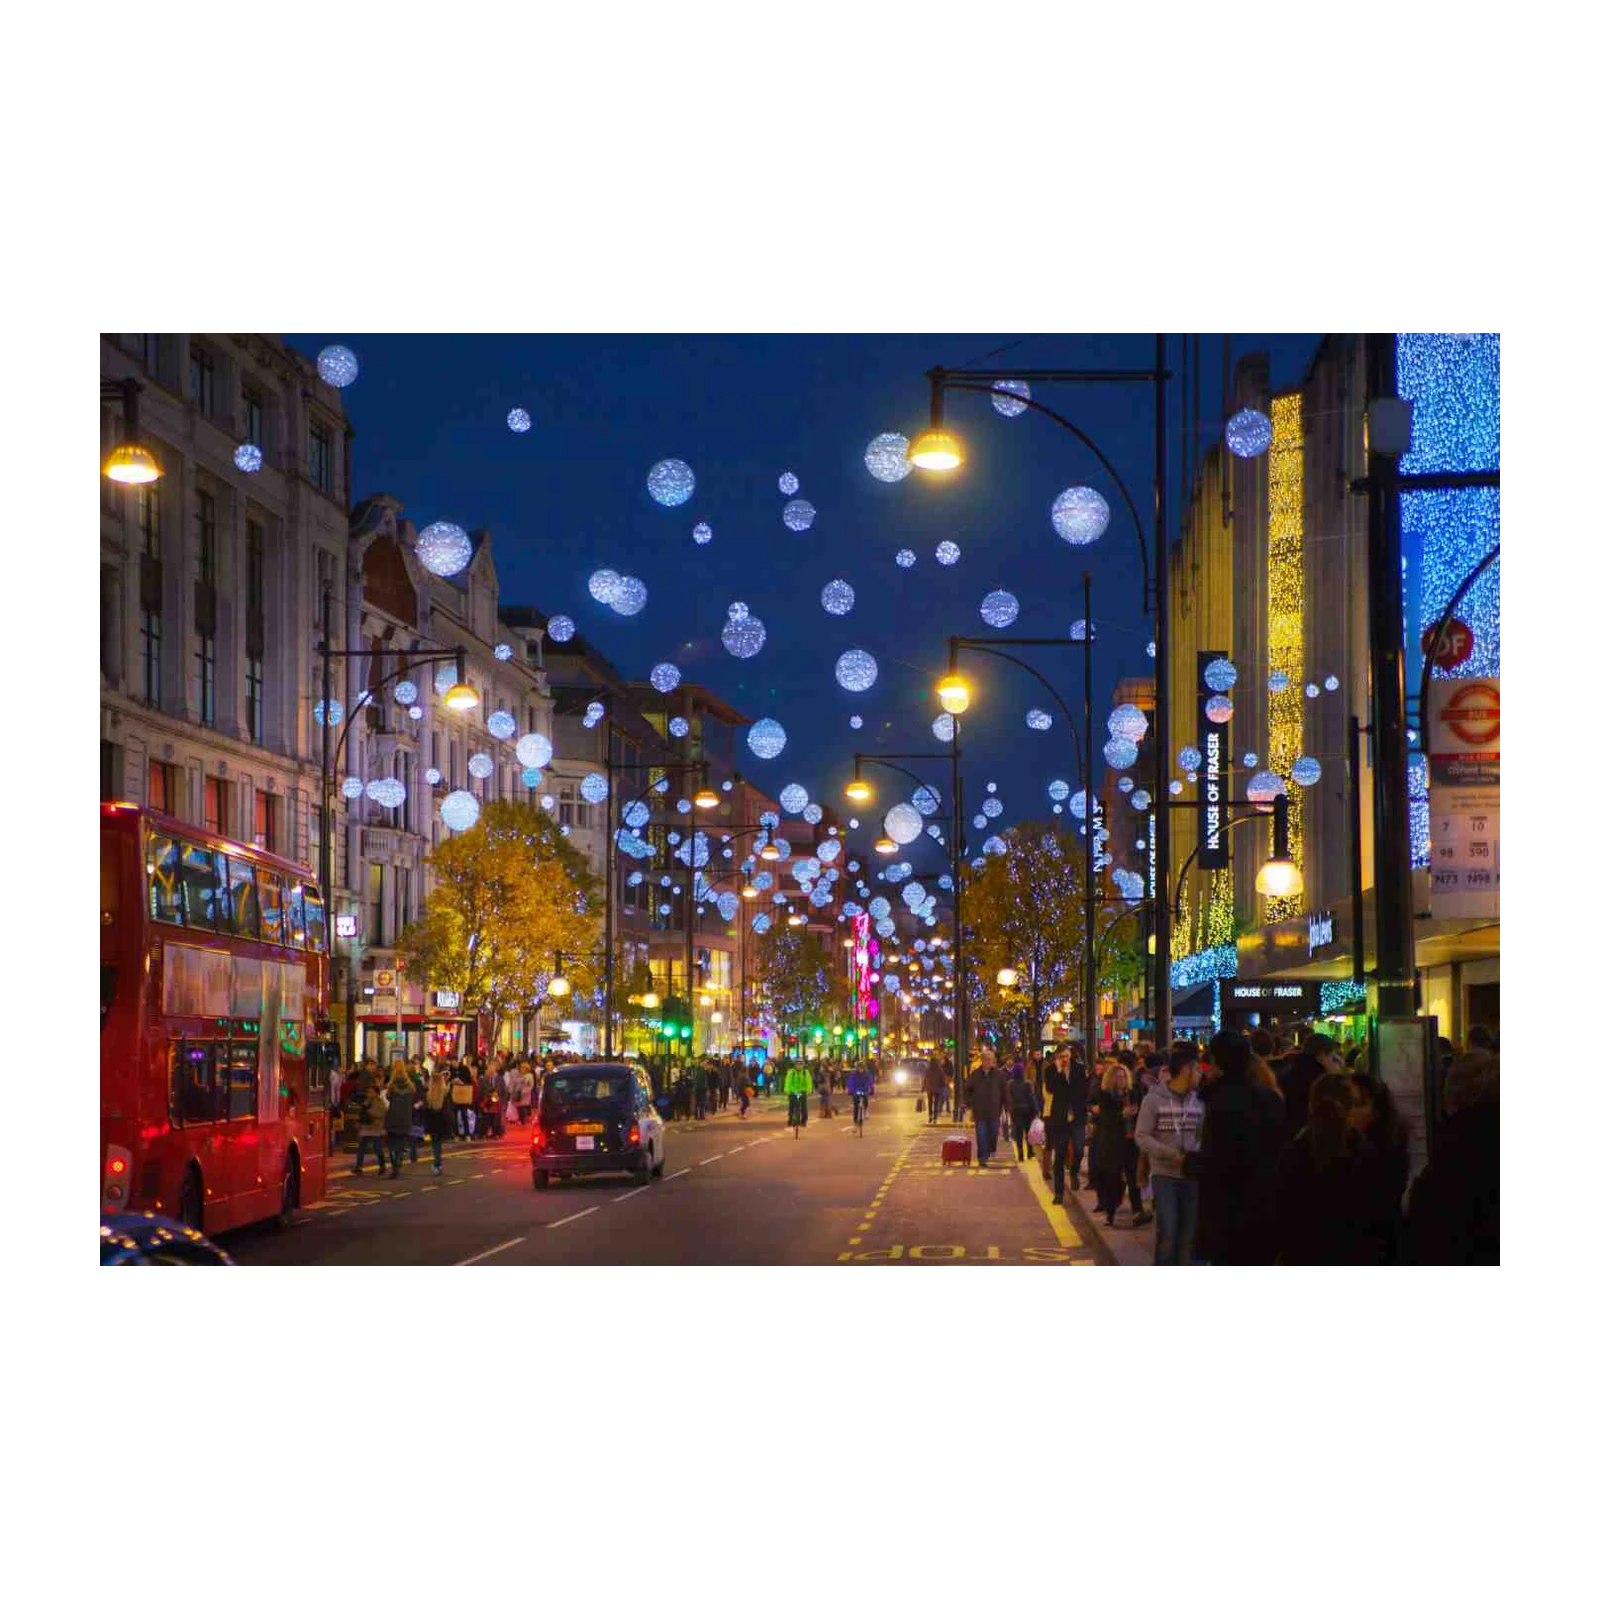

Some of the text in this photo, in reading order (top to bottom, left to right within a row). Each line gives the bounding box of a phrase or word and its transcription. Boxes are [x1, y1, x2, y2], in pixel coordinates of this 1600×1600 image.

[1207, 733, 1220, 849] HOUSE OF FRASER
[1442, 821, 1450, 832] 7
[1472, 822, 1485, 832] 10
[1439, 847, 1454, 859] 98
[1234, 987, 1260, 997] HOUSE
[1273, 987, 1302, 997] FRASER
[854, 1245, 1070, 1260] STOP
